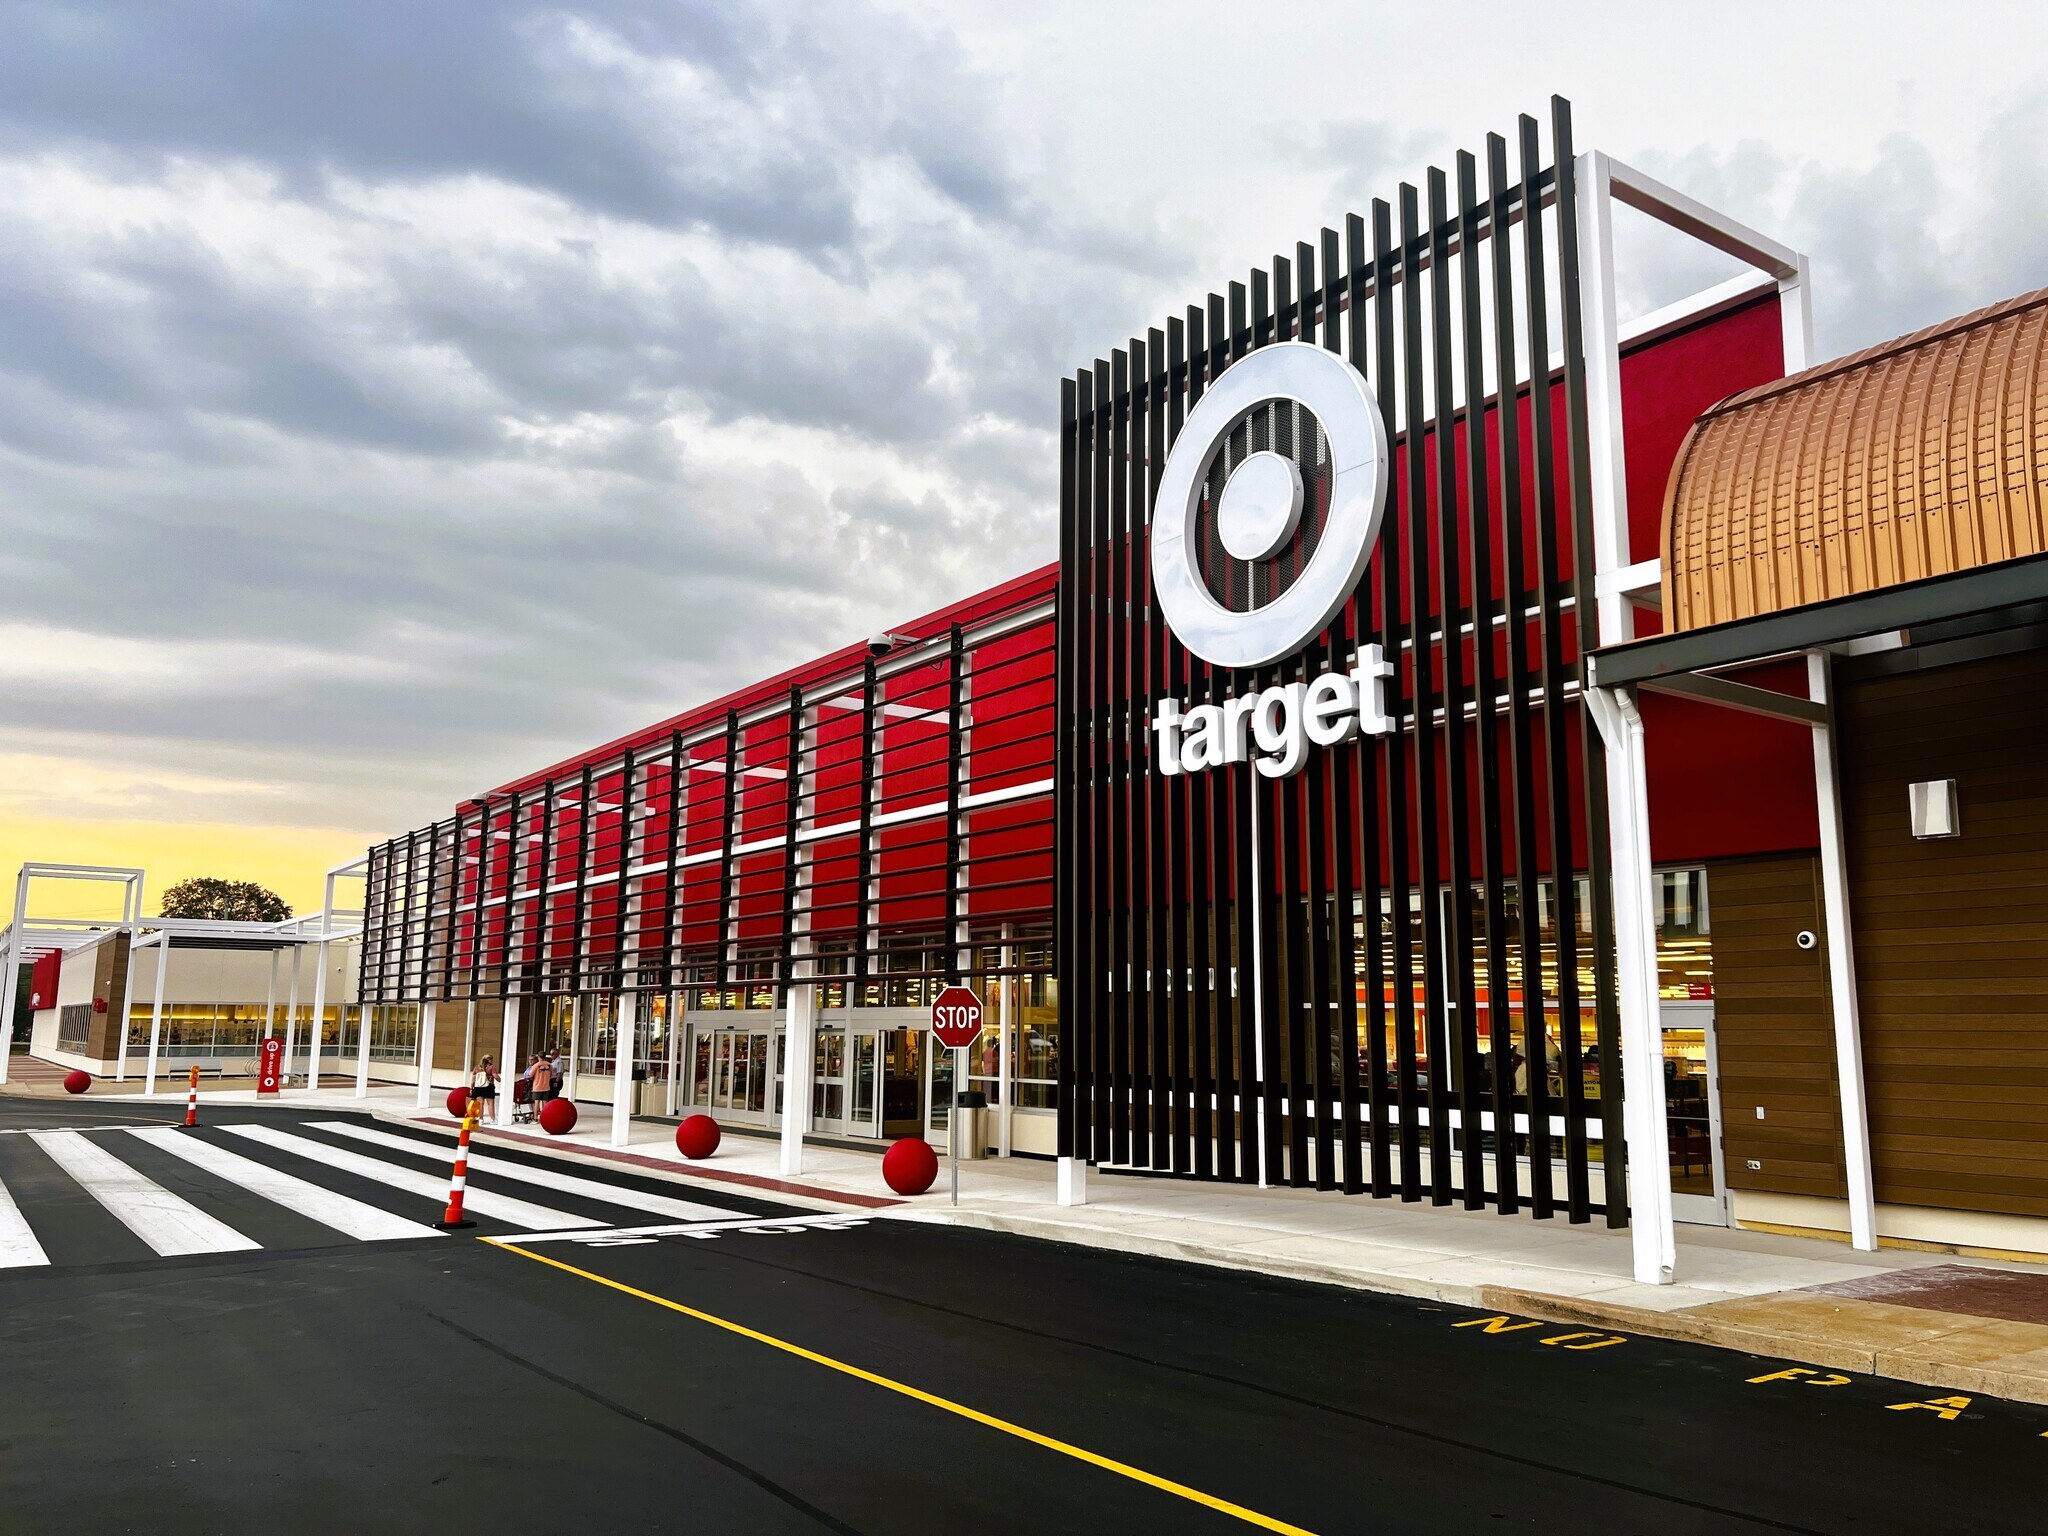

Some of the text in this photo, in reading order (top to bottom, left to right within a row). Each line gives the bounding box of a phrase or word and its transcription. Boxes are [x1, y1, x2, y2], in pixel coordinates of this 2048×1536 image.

[1152, 643, 1396, 778] target
[935, 1006, 979, 1029] STOP
[1451, 1316, 2048, 1437] NO PA
